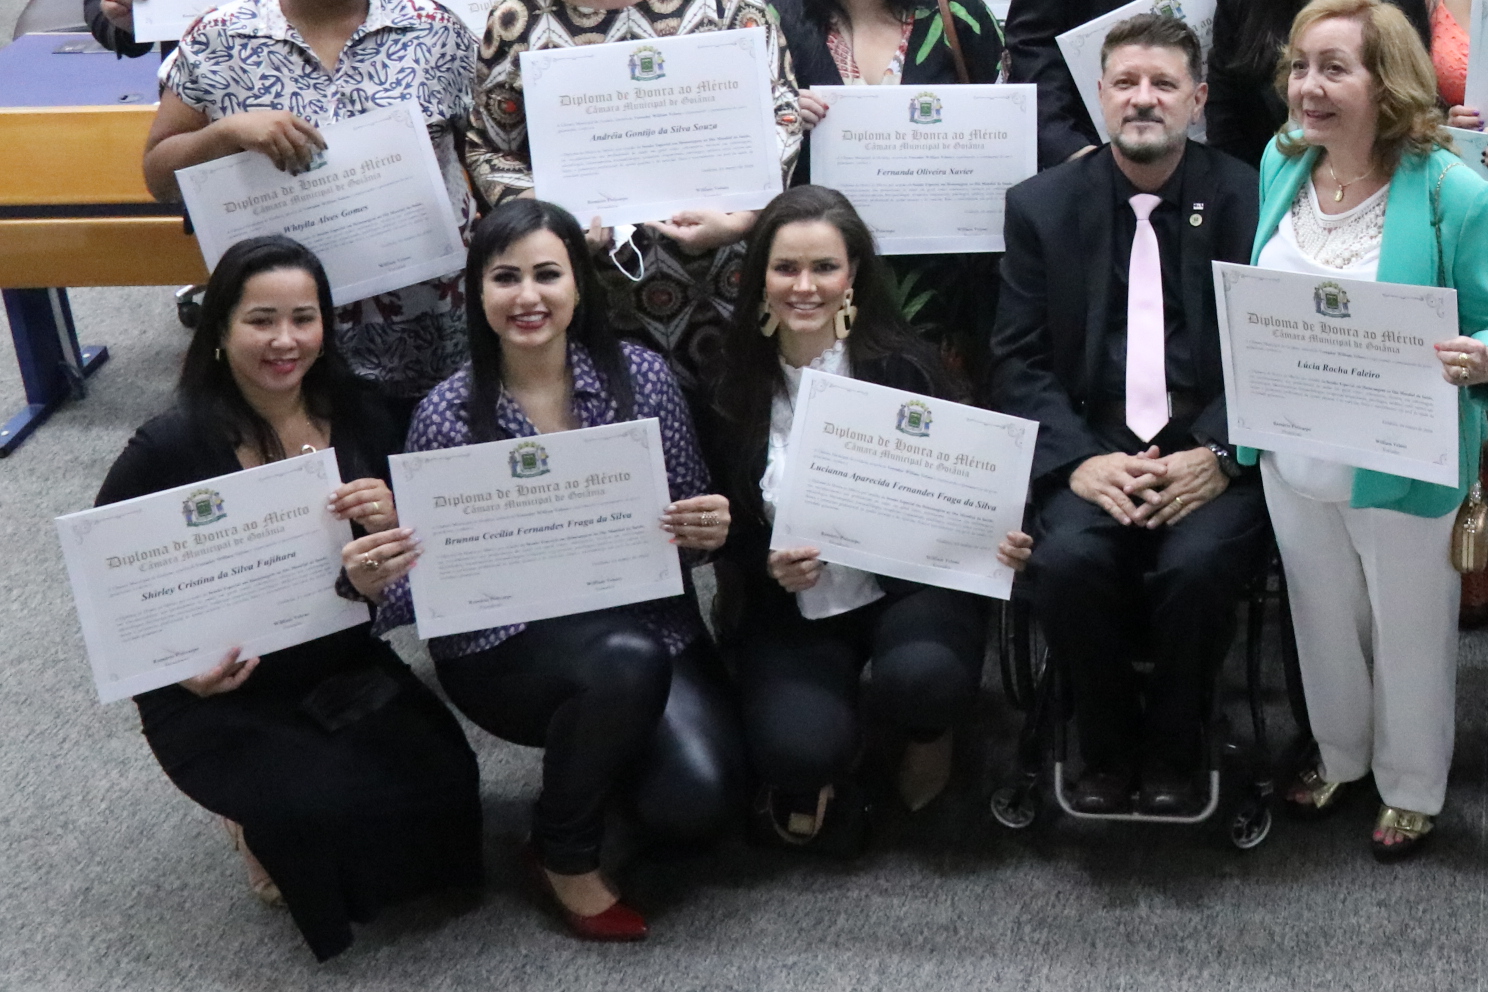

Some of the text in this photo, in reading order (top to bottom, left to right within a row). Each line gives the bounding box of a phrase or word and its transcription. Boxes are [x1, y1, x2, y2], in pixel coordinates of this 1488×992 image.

[559, 79, 739, 106] Diploma de Honra ao Mérito
[590, 122, 718, 142] Andréia Gontijo da Silva Souza
[842, 130, 1008, 142] Diploma de Honra ao Mérito
[223, 153, 402, 214] Diploma de Honra ao Mérito
[877, 168, 914, 176] Fernanda
[916, 168, 946, 176] Oliveira
[317, 213, 339, 224] Alves
[341, 205, 368, 218] Gomes
[1248, 312, 1424, 346] Diploma de Honra ao Mérito
[1297, 360, 1380, 379] Lúcia Rocha Faleiro
[823, 422, 996, 472] Diploma de Honra ao Mérito
[434, 471, 631, 508] Diploma de Honra ao Mérito
[810, 462, 996, 512] Lucianna Aparecida Fernandes Fraga da Silva
[106, 505, 310, 569] Diploma de Honra ao Mérito
[445, 535, 480, 546] Brunna
[517, 522, 564, 536] Fernandes
[567, 519, 594, 529] Fraga
[597, 516, 607, 524] da
[610, 512, 632, 521] Silva
[141, 551, 296, 602] Shirley Cristina da Silva Fujihara
